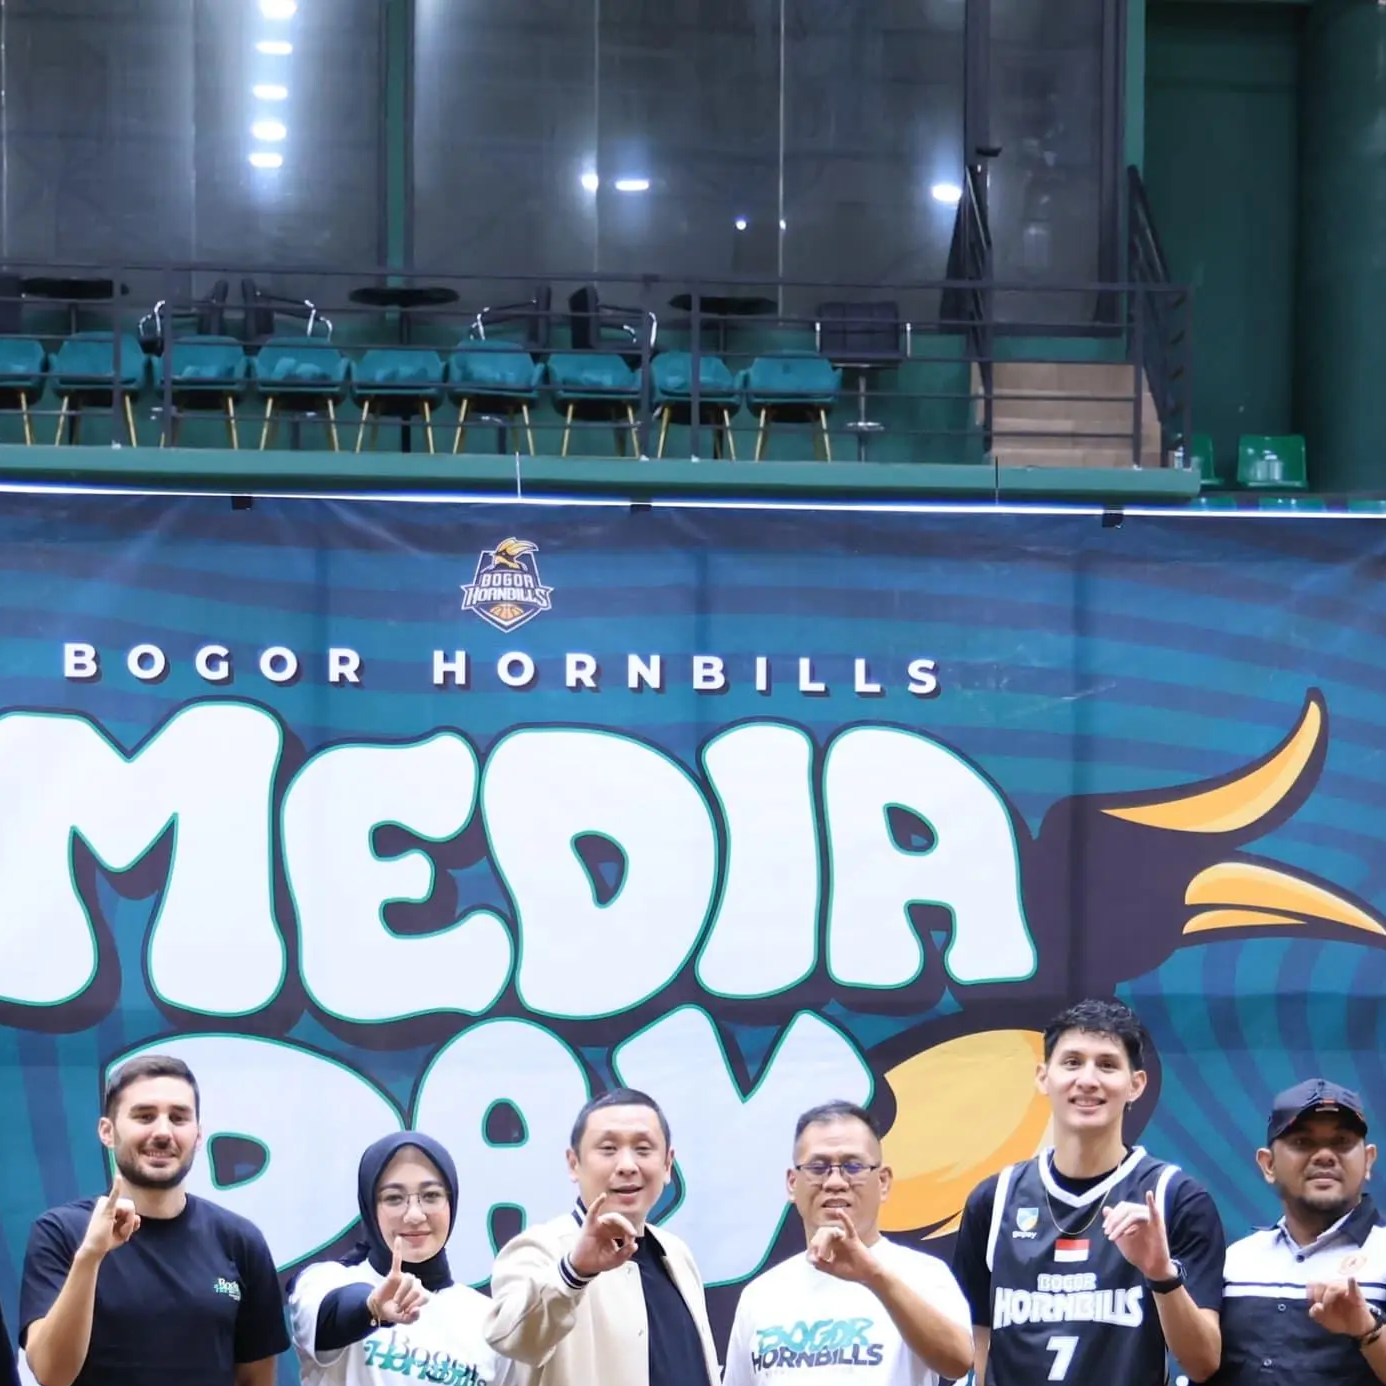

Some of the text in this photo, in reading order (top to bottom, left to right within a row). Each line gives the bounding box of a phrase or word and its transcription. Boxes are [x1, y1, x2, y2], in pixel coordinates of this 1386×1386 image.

[466, 587, 548, 607] HORNBILLS
[480, 573, 534, 589] BOGOR
[63, 642, 938, 694] BOGOR HORNBILLS
[105, 1004, 875, 1288] DAY
[1037, 1272, 1097, 1293] BOGOR
[993, 1285, 1144, 1330] HORNBILLS
[756, 1317, 875, 1354] BOGOR
[752, 1344, 884, 1374] HORNBILLS
[1046, 1336, 1079, 1381] 7
